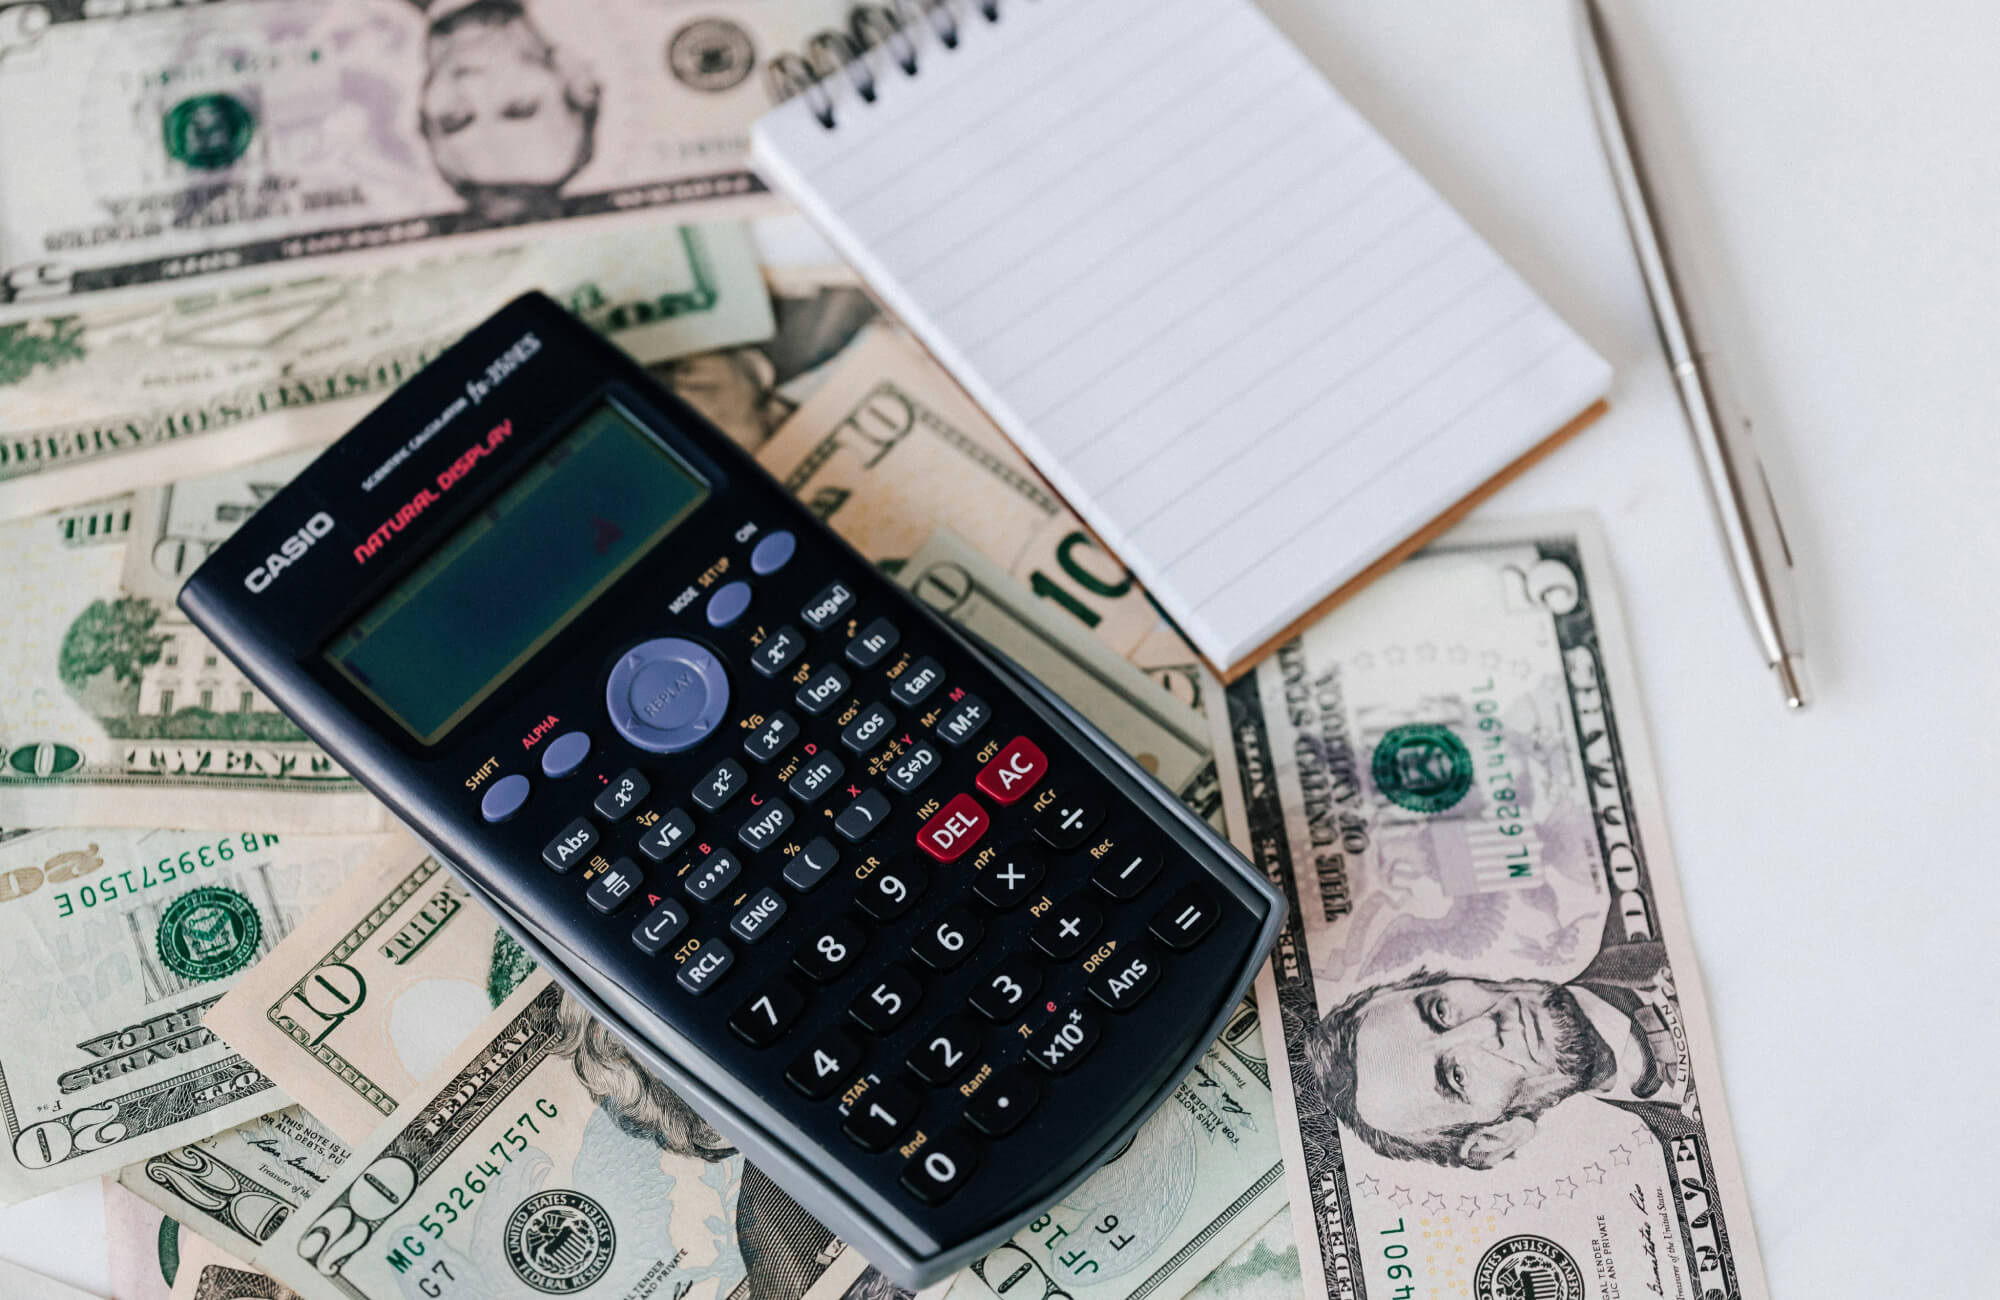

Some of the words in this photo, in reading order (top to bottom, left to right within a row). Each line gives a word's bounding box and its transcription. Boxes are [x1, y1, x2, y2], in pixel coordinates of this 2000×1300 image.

[353, 488, 440, 564] NATURAL
[436, 418, 513, 491] DISPLAY
[734, 521, 758, 543] ON
[244, 512, 335, 593] CASIO
[668, 585, 700, 615] MODE
[863, 633, 887, 653] ln
[643, 672, 693, 717] REPLAY
[807, 674, 842, 703] log
[904, 667, 936, 695] tan
[949, 687, 966, 703] M
[1471, 676, 1495, 694] L
[521, 714, 560, 751] ALPHA
[856, 712, 885, 741] cos
[948, 704, 981, 737] M+
[804, 743, 818, 756] D
[901, 733, 913, 746] Y
[1315, 662, 1362, 811] AMERICA
[975, 740, 1000, 766] OFF
[1237, 721, 1269, 799] NOTE
[1477, 699, 1524, 838] 62814490
[465, 756, 501, 792] SHIFT
[804, 763, 832, 790] sin
[998, 752, 1034, 791] AC
[750, 793, 763, 807] C
[1032, 787, 1058, 813] nCr
[1295, 732, 1339, 851] UNITED
[1561, 645, 1657, 942] DOLLARS
[747, 808, 784, 841] hyp
[916, 798, 940, 821] INS
[556, 829, 590, 862] Abs
[932, 810, 979, 850] DEL
[1340, 813, 1368, 854] OF
[699, 843, 712, 855] B
[973, 845, 997, 871] nPr
[1090, 836, 1115, 860] Rec
[1507, 843, 1533, 879] ML
[79, 837, 235, 910] 93957150
[855, 856, 881, 881] CLR
[647, 892, 661, 907] A
[879, 874, 907, 903] 9
[1314, 852, 1353, 922] THE
[53, 893, 75, 918] E
[740, 895, 779, 932] ENG
[1029, 895, 1054, 919] Pol
[674, 937, 701, 965] STO
[816, 934, 847, 963] 8
[936, 923, 965, 952] 6
[688, 950, 725, 983] RCL
[1106, 958, 1149, 1000] Ans
[871, 983, 902, 1015] 5
[991, 974, 1023, 1004] 3
[750, 996, 779, 1027] 7
[929, 1037, 964, 1068] 2
[1660, 1005, 1688, 1081] LINCOLN
[57, 1023, 229, 1096] TATES
[813, 1049, 840, 1078] 4
[1215, 1058, 1247, 1089] Treasurer
[192, 1070, 261, 1103] OTE
[420, 1022, 540, 1135] FEDERAL
[959, 1063, 993, 1098] Ran#
[869, 1103, 897, 1127] 1
[1172, 1090, 1198, 1115] NOTE
[1204, 1109, 1223, 1127] ALL
[12, 1100, 128, 1169] 20
[274, 1122, 293, 1136] ALL
[280, 1113, 304, 1130] THIS
[302, 1127, 330, 1147] NOTE
[328, 1142, 340, 1153] IS
[1194, 1112, 1216, 1133] THIS
[1220, 1124, 1240, 1144] FOR
[899, 1130, 928, 1160] Rnd
[257, 1163, 293, 1187] Treasurer
[924, 1152, 957, 1183] 0
[146, 1146, 291, 1246] 20
[386, 1235, 426, 1275] MG
[419, 1112, 541, 1240] 53264757
[535, 1098, 559, 1118] G
[297, 1154, 420, 1277] 20
[508, 1209, 533, 1257] UNITED
[528, 1194, 567, 1216] STATES
[579, 1200, 611, 1243] SYSTEM
[1380, 1217, 1404, 1235] L
[1659, 1212, 1672, 1239] United
[1674, 1134, 1730, 1300] FIVE
[1320, 1170, 1355, 1300] EDERAL
[1510, 1240, 1558, 1261] SYSTEM
[1597, 1215, 1612, 1259] PRIVATE
[570, 1241, 610, 1290] RESERVE
[656, 1246, 688, 1283] PRIVATE
[1479, 1252, 1503, 1285] STATES
[1592, 1239, 1605, 1279] TENDER
[1606, 1260, 1618, 1282] AND
[518, 1261, 568, 1291] FEDERAL
[632, 1258, 665, 1294] TENDER
